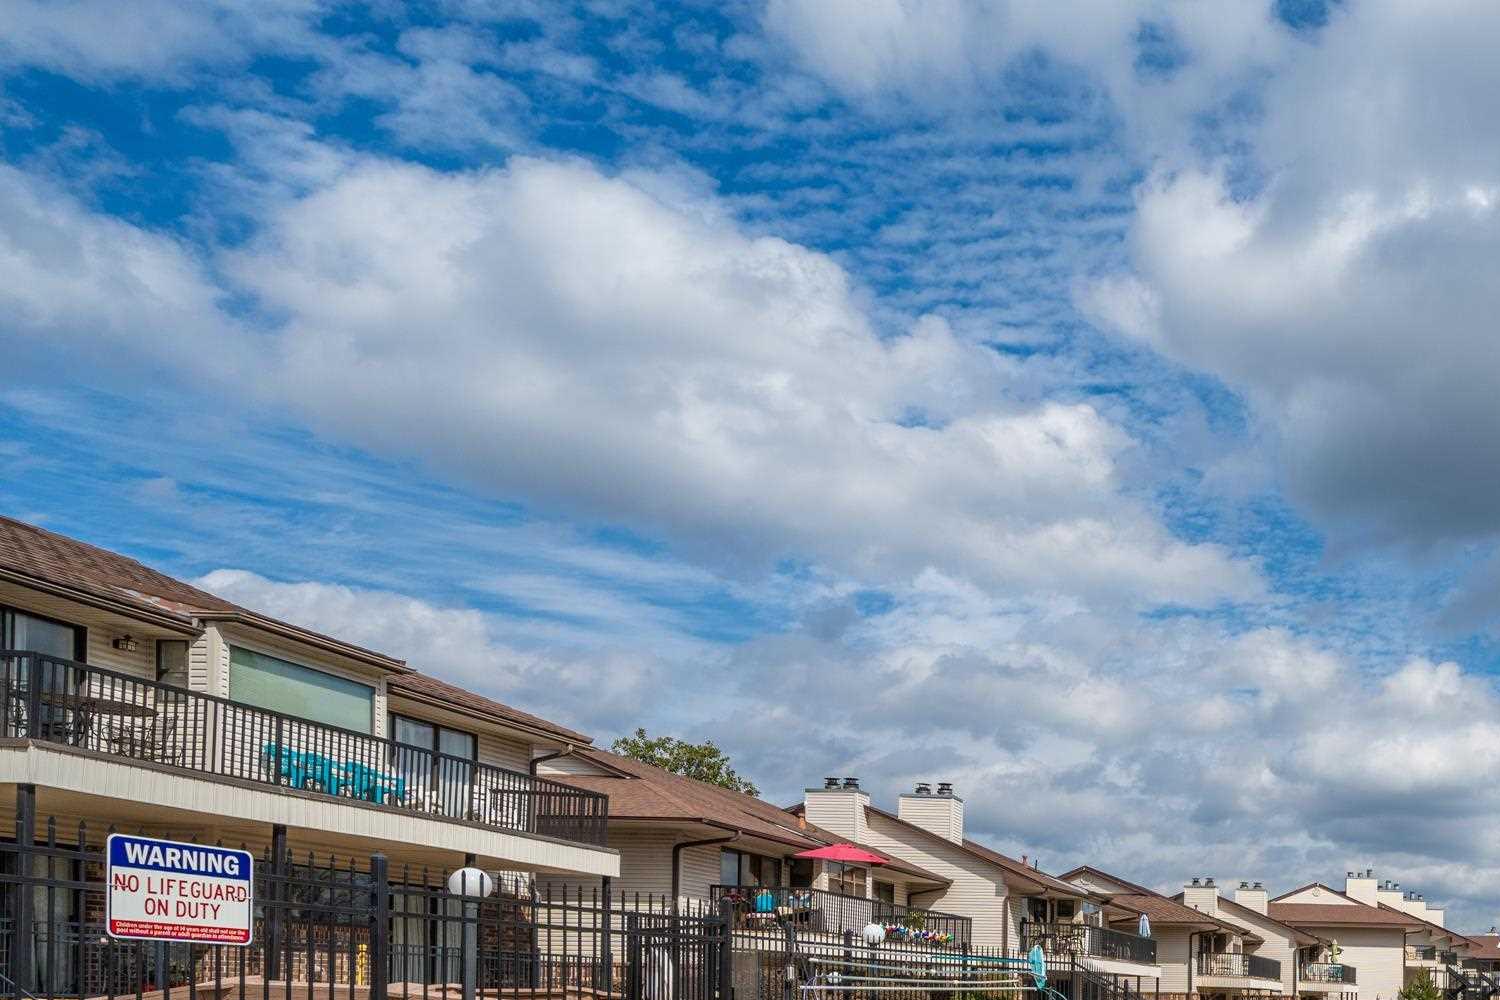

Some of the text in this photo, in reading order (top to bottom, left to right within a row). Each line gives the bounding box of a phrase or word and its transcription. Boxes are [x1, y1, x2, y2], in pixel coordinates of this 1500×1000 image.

[124, 842, 240, 876] WARNING
[114, 873, 247, 902] NO LIFEGUARD
[145, 898, 220, 920] ON DUTY
